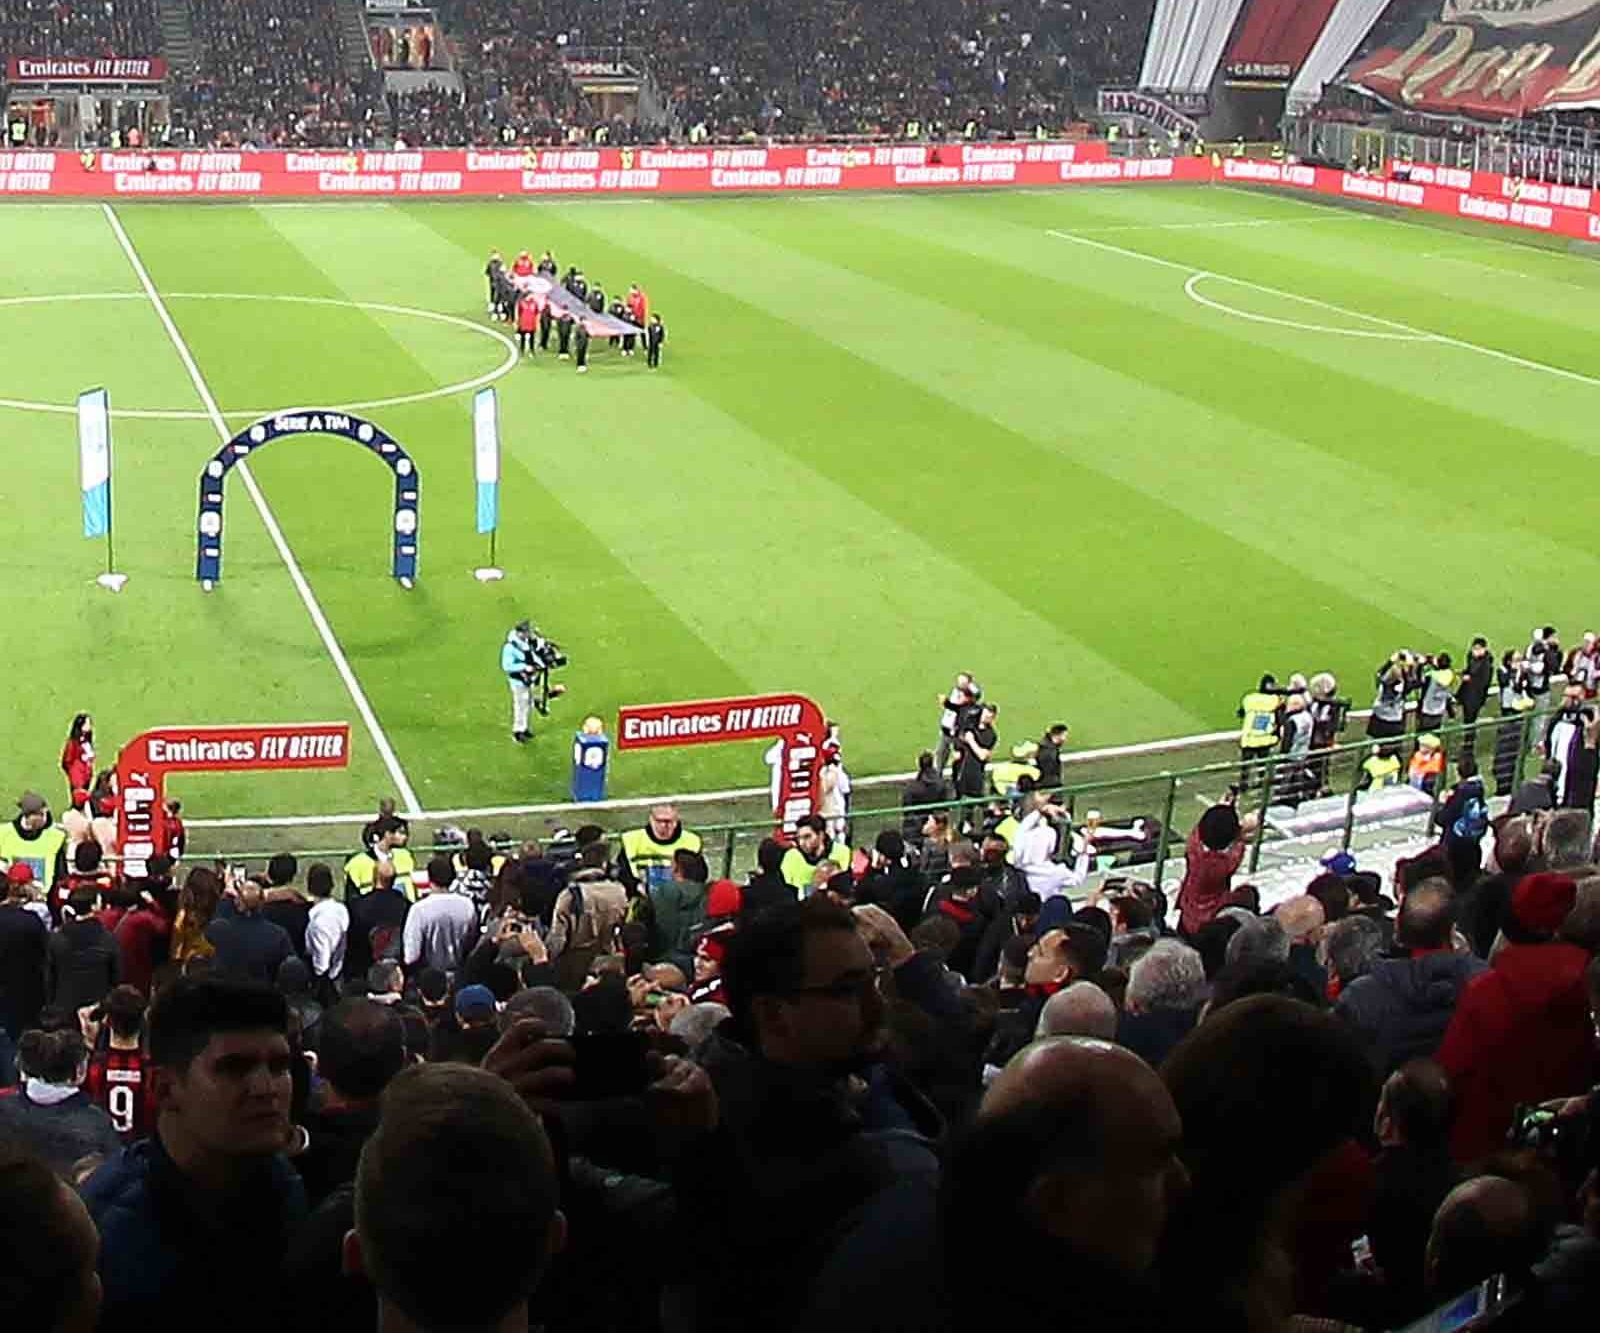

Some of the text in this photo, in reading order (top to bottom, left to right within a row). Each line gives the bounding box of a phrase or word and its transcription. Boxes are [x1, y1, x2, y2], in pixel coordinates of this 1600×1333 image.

[18, 59, 90, 76] Emirates
[1362, 20, 1554, 104] Non
[640, 150, 708, 169] Emirates
[962, 146, 1023, 163] Emirates
[711, 169, 782, 187] Emirates
[895, 166, 960, 183] Emirates
[1060, 161, 1121, 179] Emirates
[114, 173, 193, 191] Emirates
[319, 172, 396, 190] Emirates
[522, 171, 596, 189] Emirates
[310, 414, 322, 430] A
[324, 414, 350, 430] TIM
[624, 703, 801, 741] Emirates FLY BETTER
[148, 734, 343, 763] Emirates FLY BETTER
[108, 1085, 134, 1133] 9
